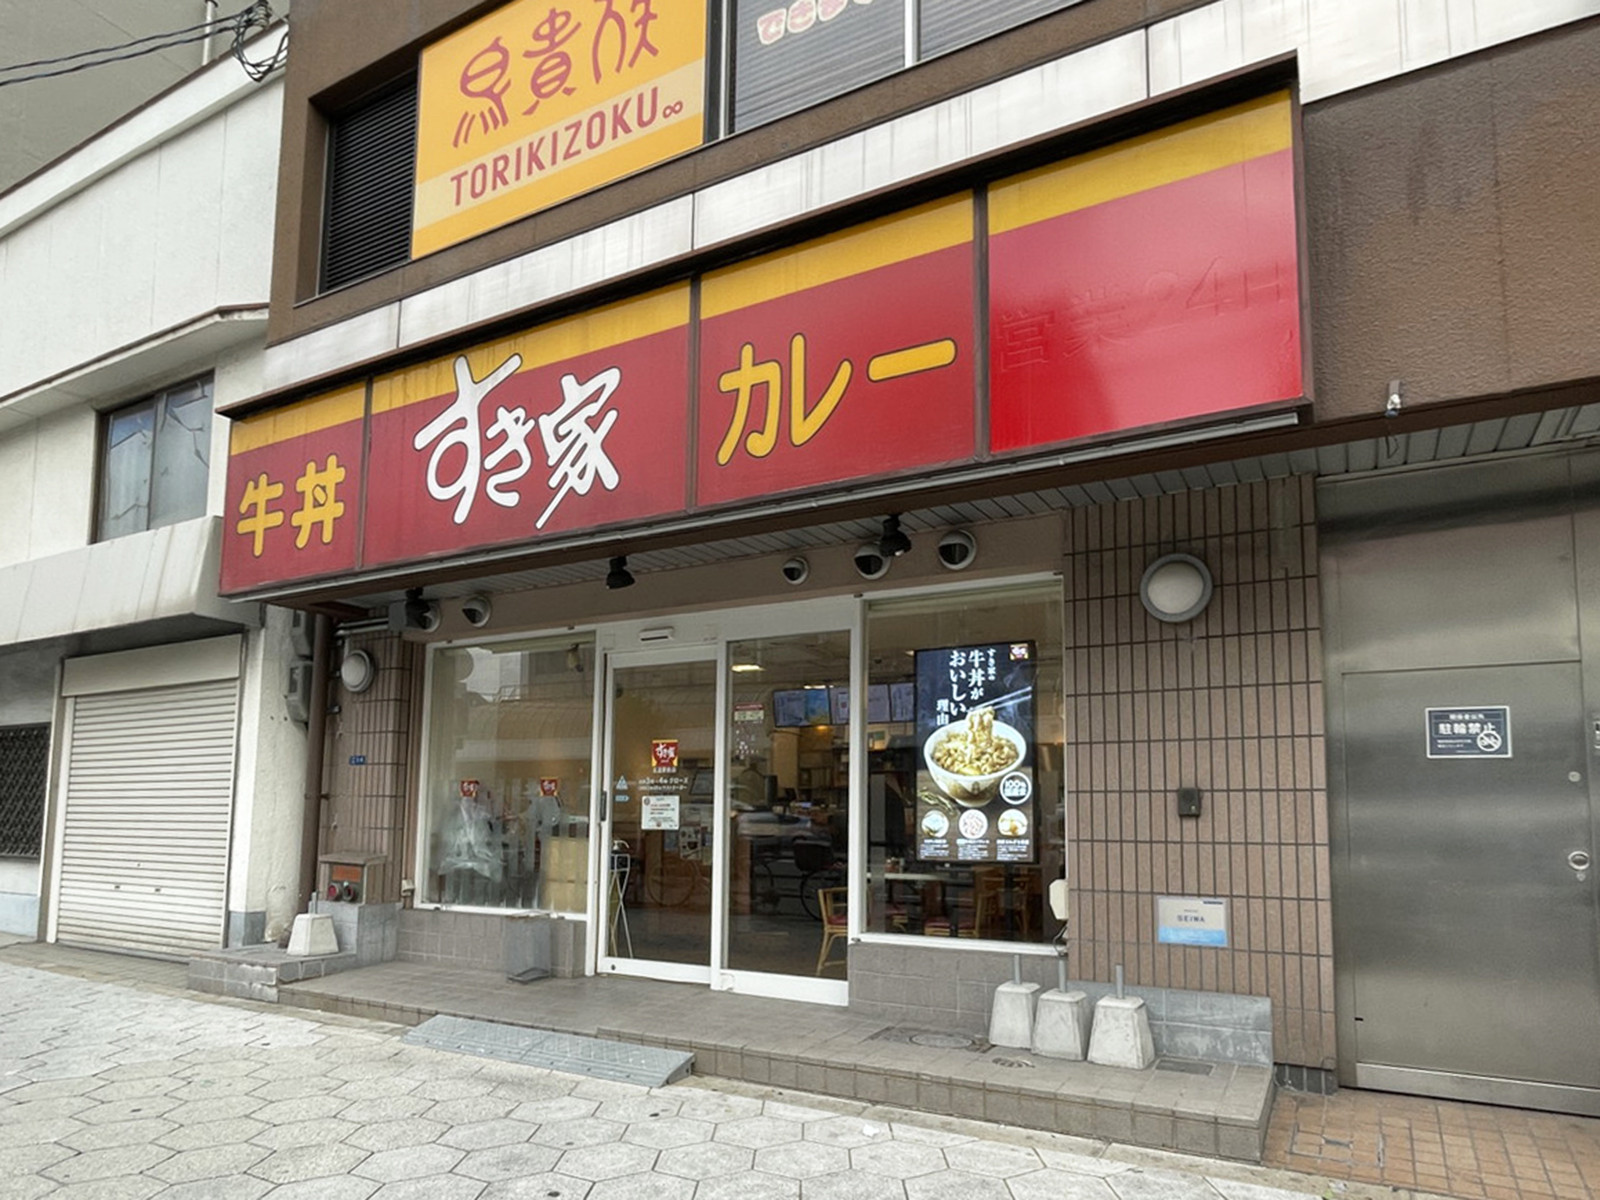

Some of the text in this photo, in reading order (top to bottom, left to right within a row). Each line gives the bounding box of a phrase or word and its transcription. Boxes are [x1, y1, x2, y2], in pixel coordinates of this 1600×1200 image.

[450, 86, 659, 207] TORIKIZOKU
[413, 353, 622, 530] すき家
[716, 333, 957, 467] カレー
[236, 453, 347, 558] 牛丼
[949, 649, 967, 716] おいしい
[968, 649, 986, 700] 牛丼が
